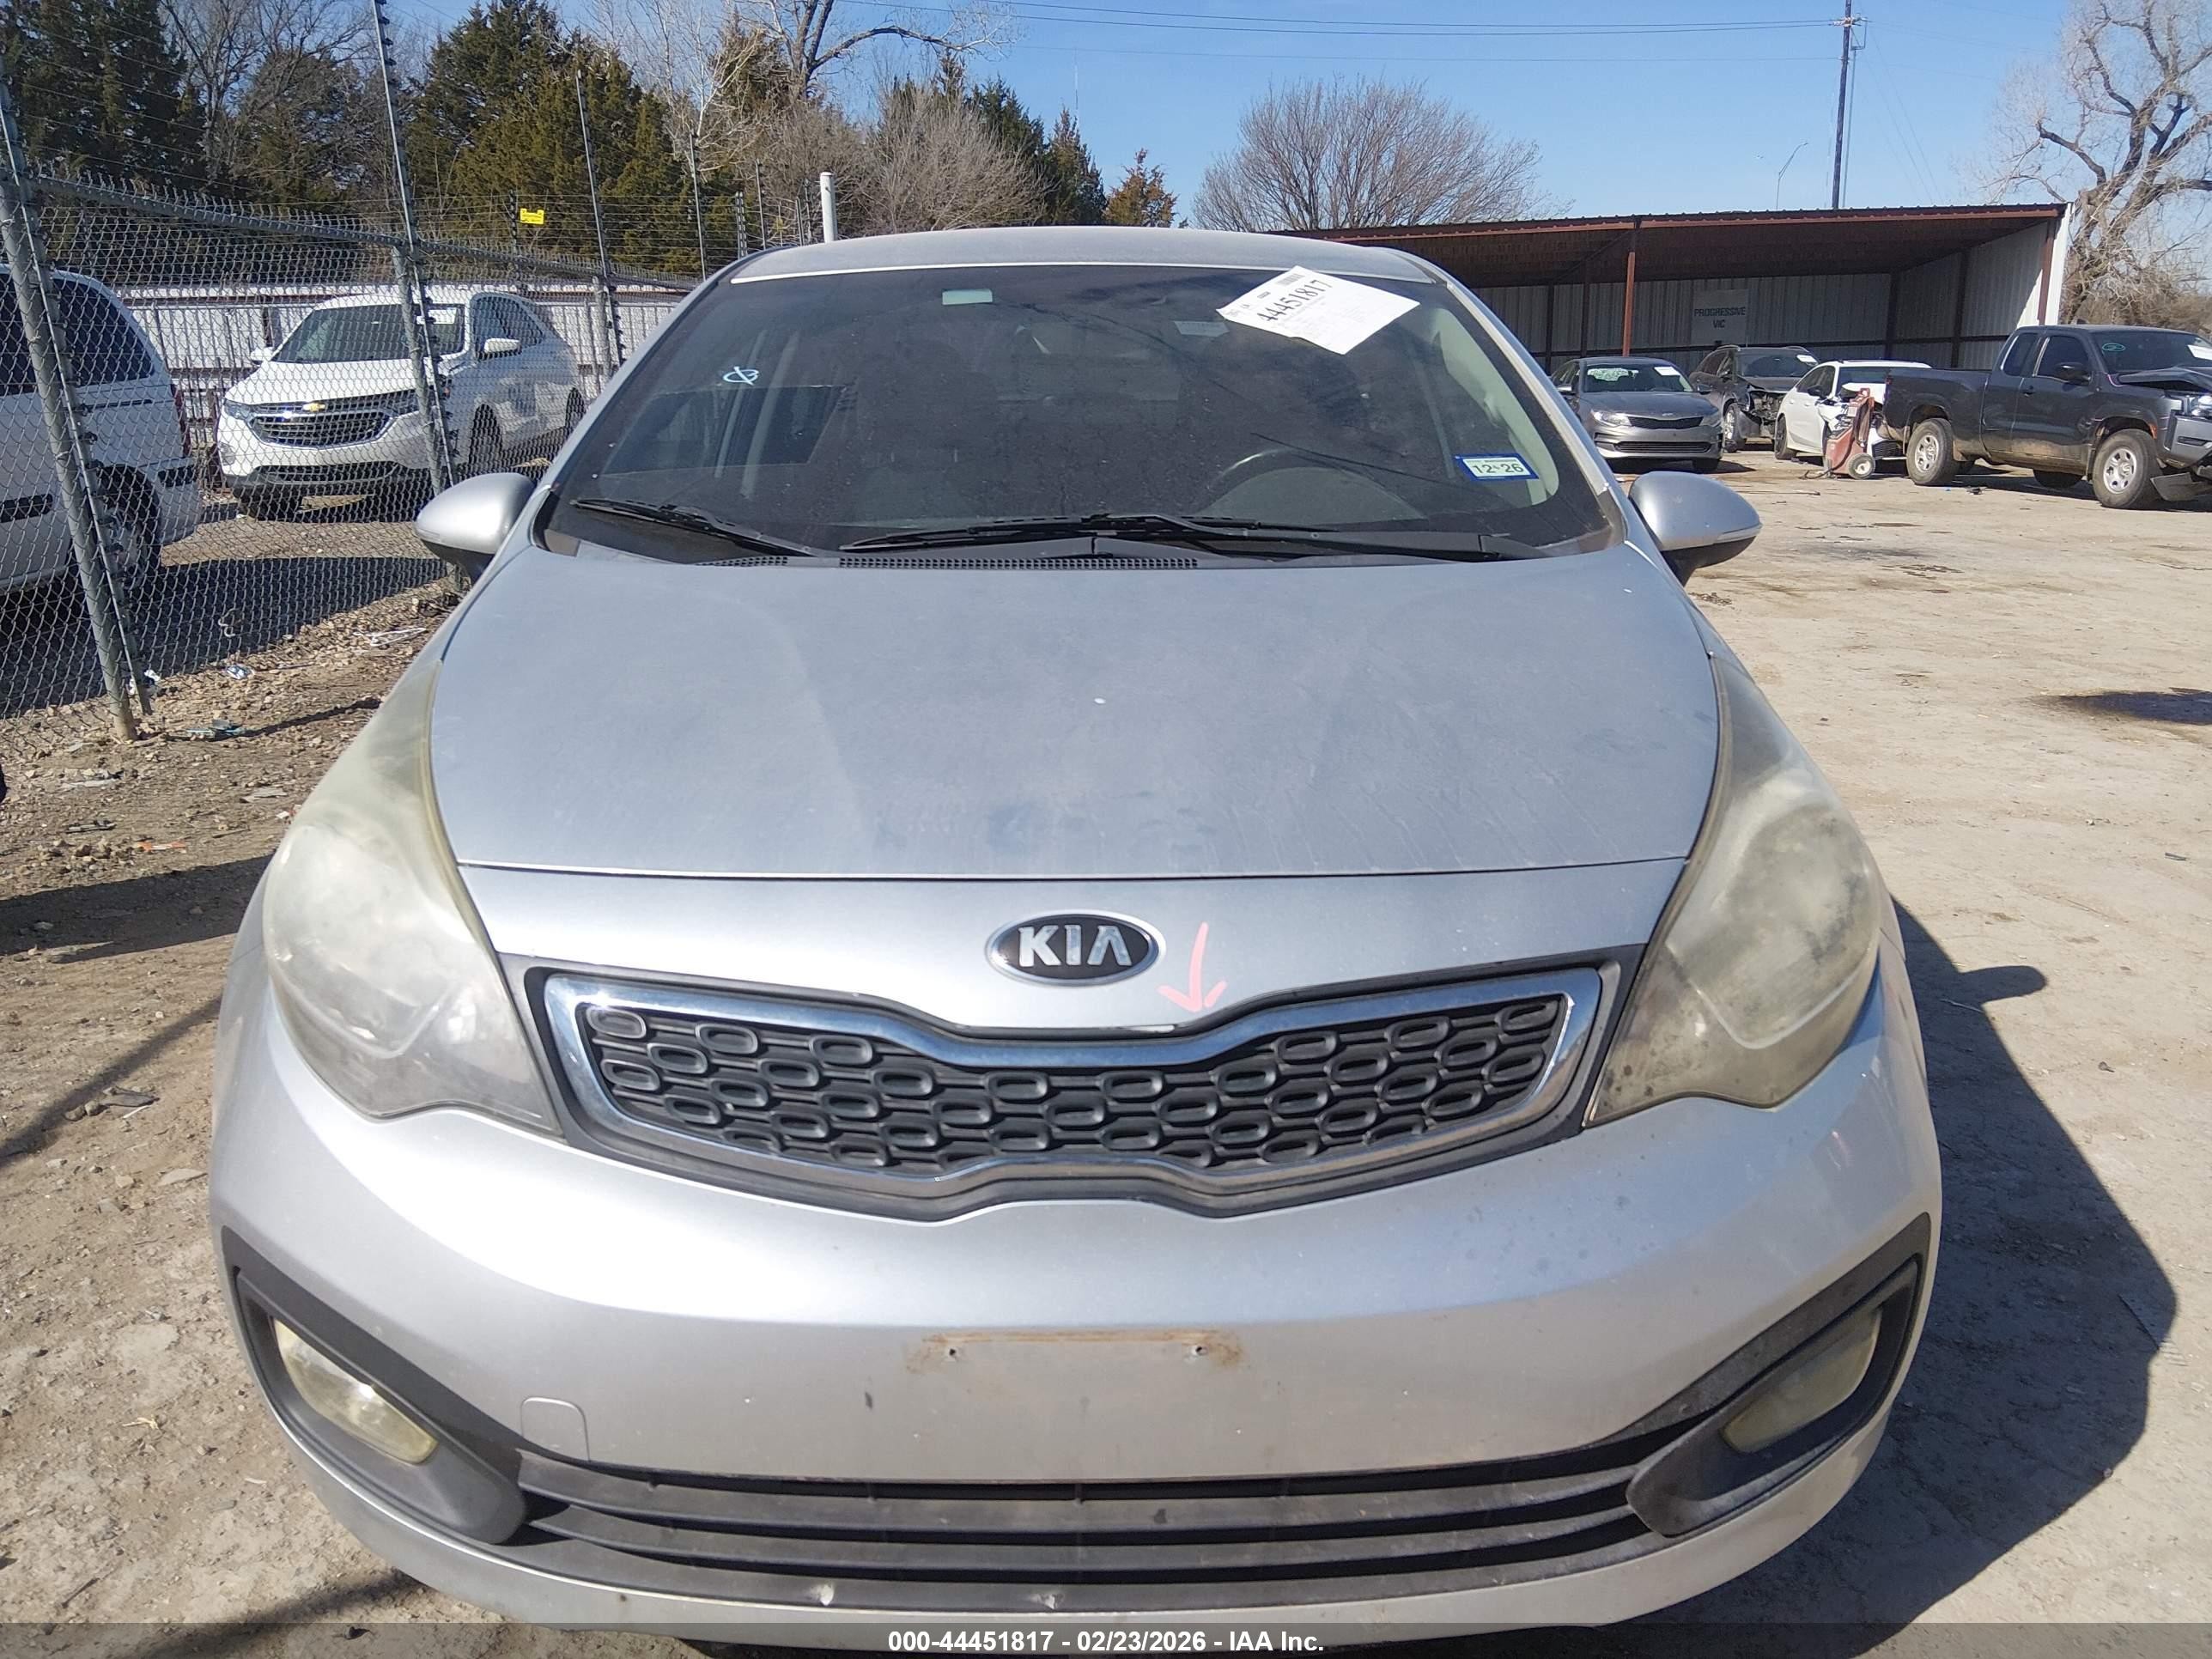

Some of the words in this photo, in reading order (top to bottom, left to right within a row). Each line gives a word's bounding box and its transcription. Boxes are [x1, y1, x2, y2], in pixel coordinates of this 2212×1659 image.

[1257, 279, 1333, 321] 44451817
[1693, 307, 1746, 317] PROGRESSIVE
[1018, 924, 1132, 967] KIA
